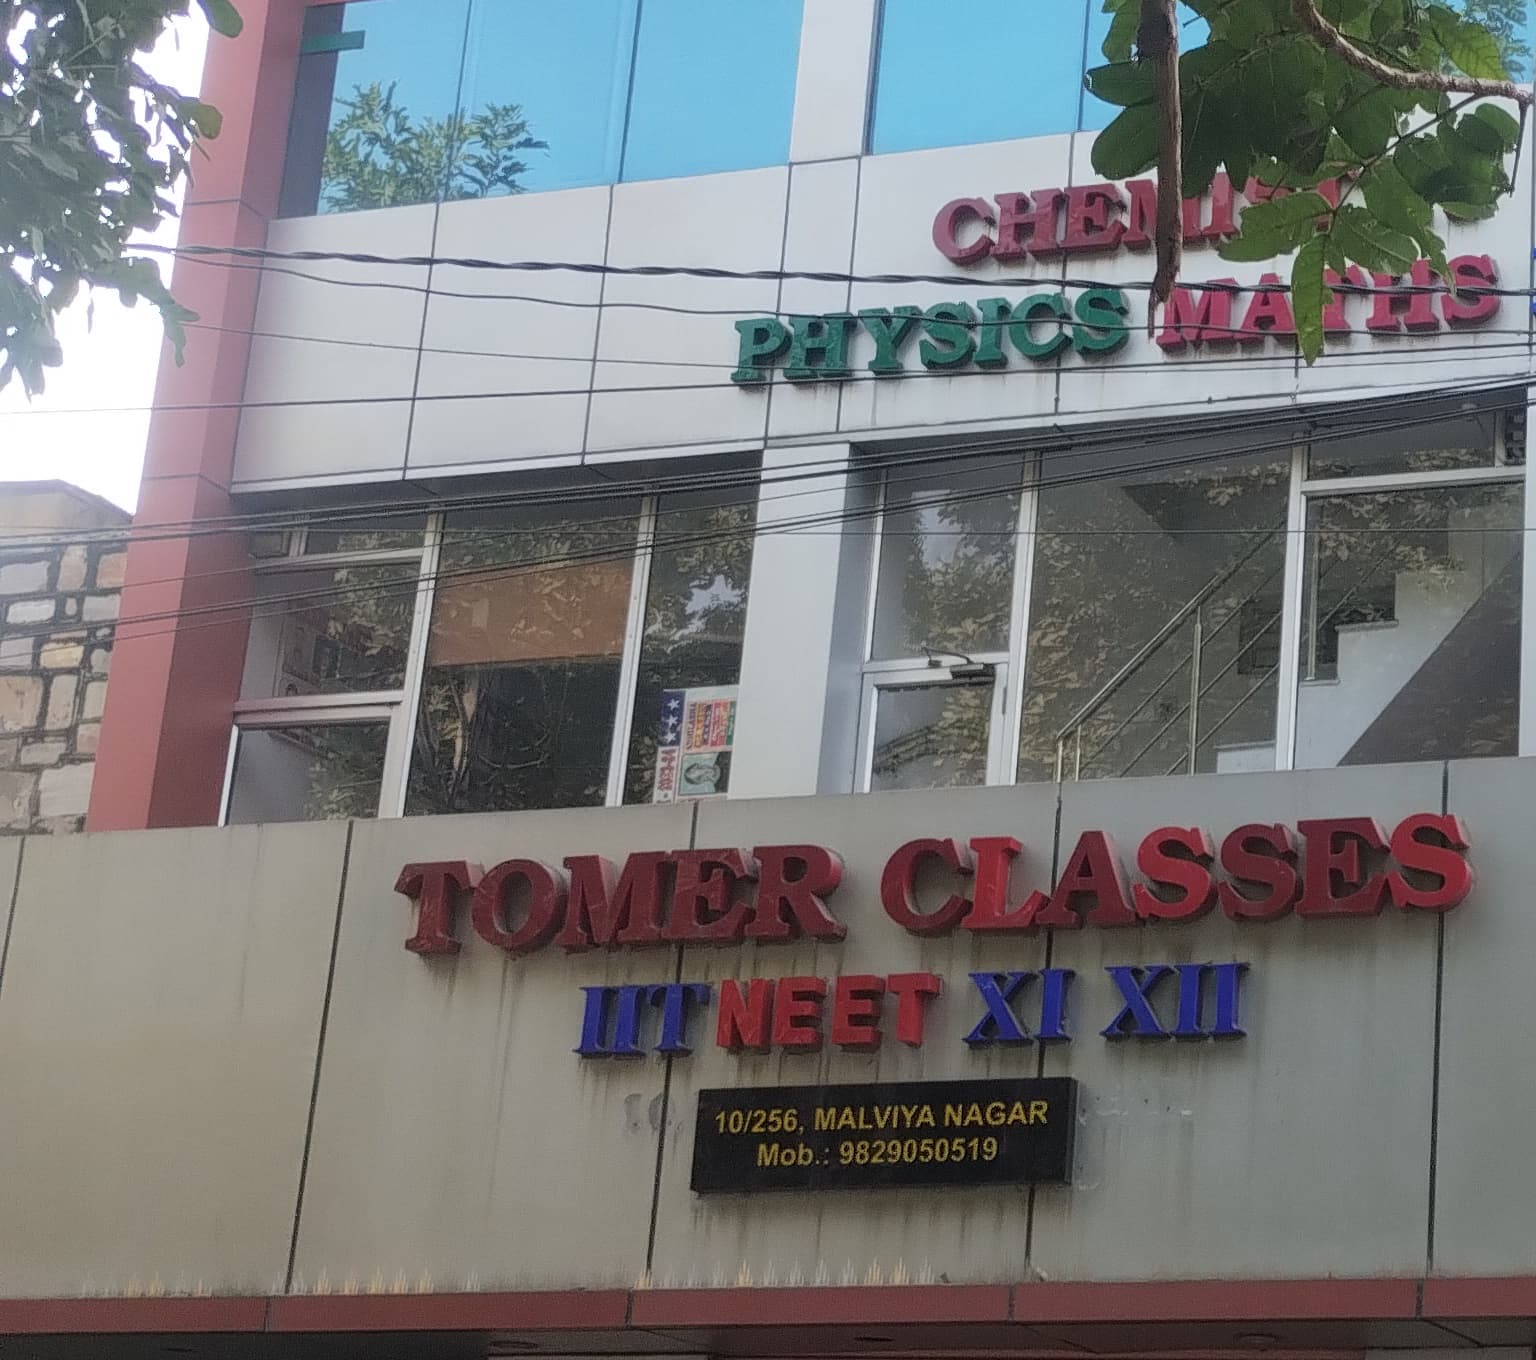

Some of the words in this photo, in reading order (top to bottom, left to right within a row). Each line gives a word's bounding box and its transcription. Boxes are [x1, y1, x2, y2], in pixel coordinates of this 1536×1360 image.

[731, 288, 1131, 382] PHYSICS
[395, 843, 846, 956] TOMER
[880, 812, 1474, 937] CLASSES
[576, 982, 710, 1057] IIT
[716, 973, 943, 1051] NEET
[963, 967, 1075, 1044] XI
[1100, 961, 1250, 1040] XII
[714, 1109, 804, 1136] 10/256,
[814, 1104, 936, 1131] MALVIYA
[944, 1100, 1048, 1127] NAGAR
[756, 1143, 830, 1167] Mob.:
[839, 1137, 998, 1165] 9829050519
